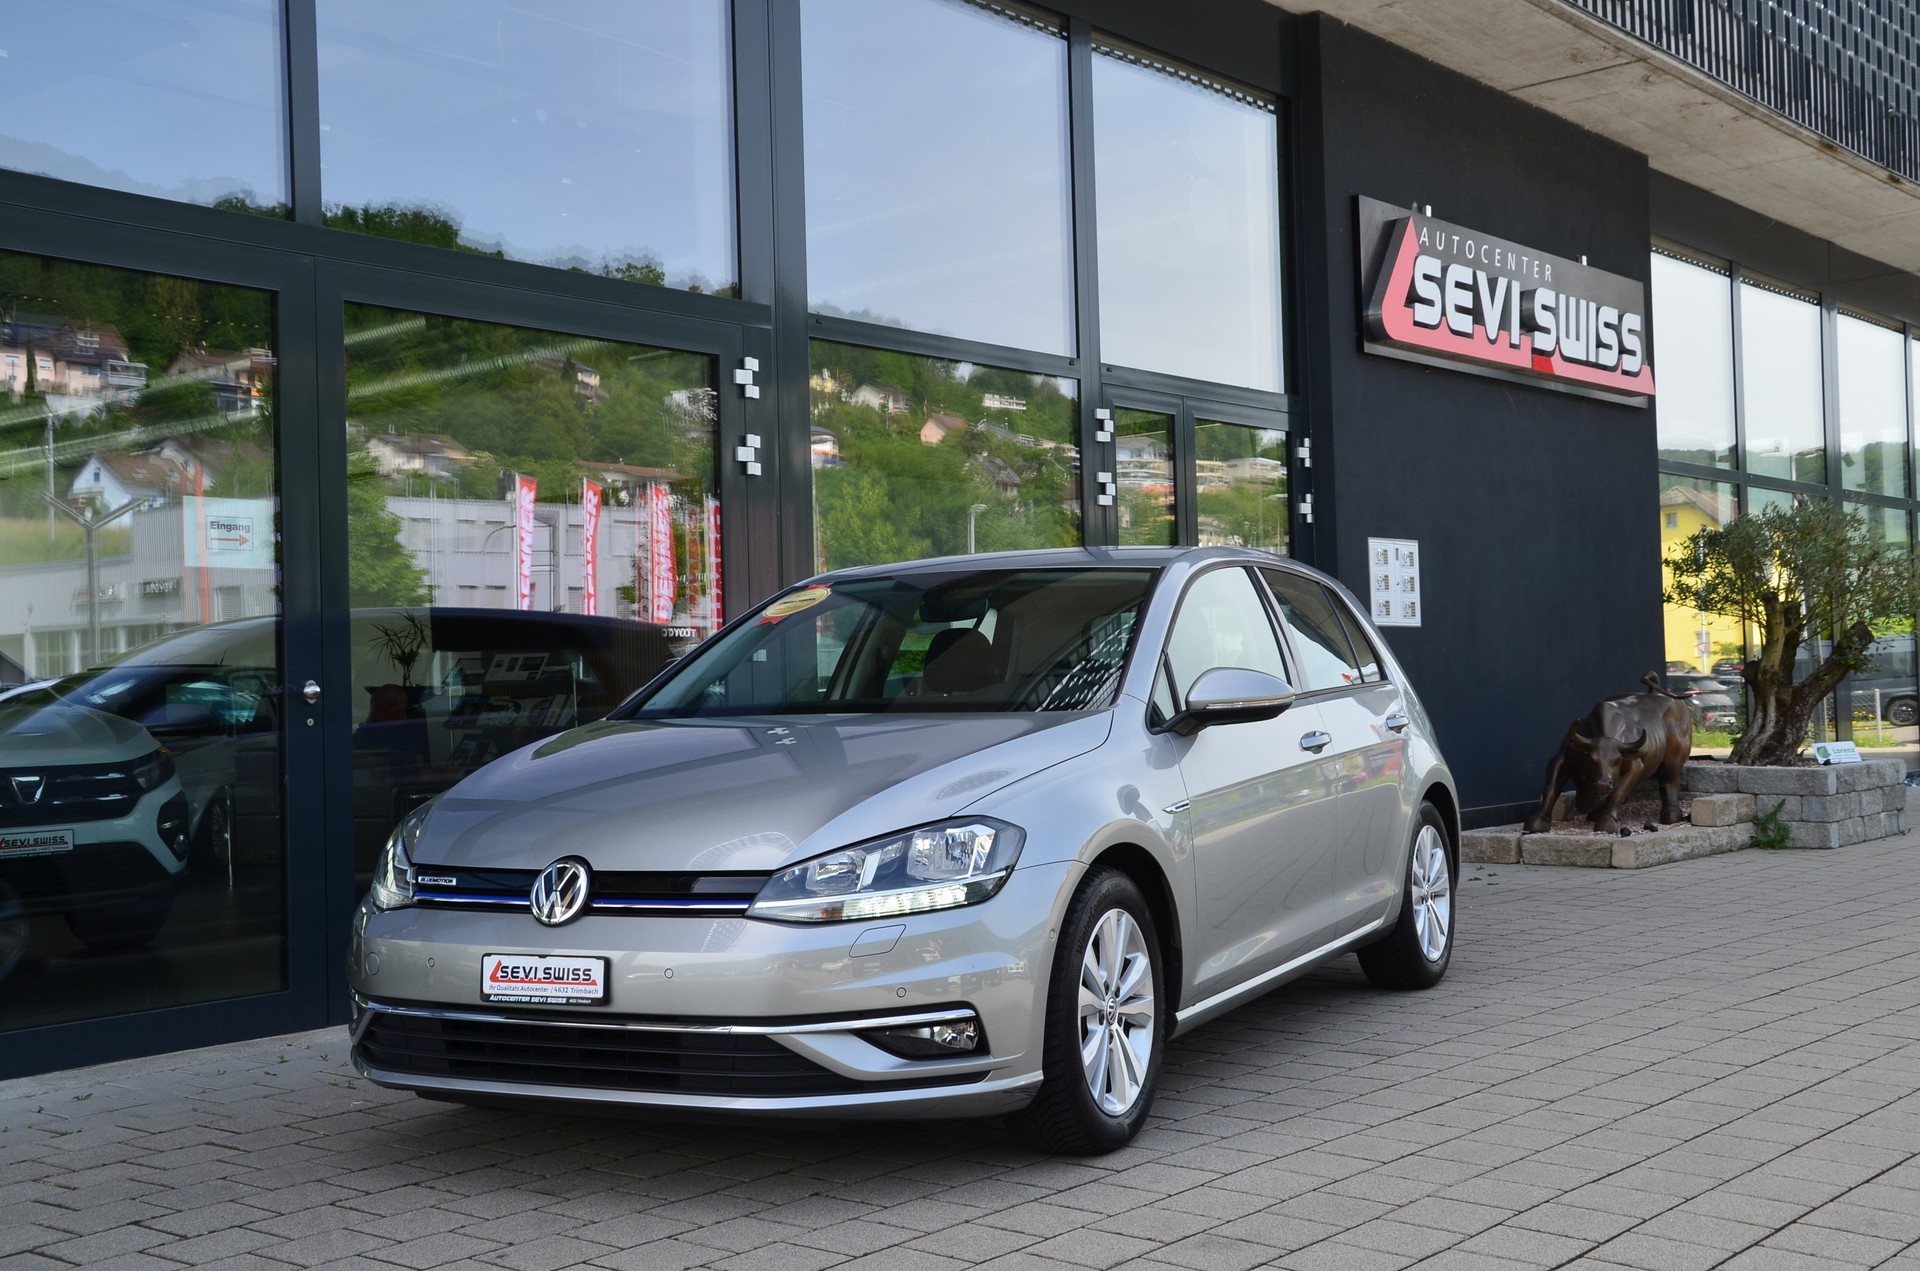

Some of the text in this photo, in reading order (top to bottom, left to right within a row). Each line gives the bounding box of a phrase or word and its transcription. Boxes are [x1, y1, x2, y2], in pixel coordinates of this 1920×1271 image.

[1419, 226, 1552, 282] AUTOCENTER
[1412, 254, 1642, 373] SEVI SWISS
[210, 521, 251, 533] Eingang
[4, 836, 66, 847] SEVI SWISS
[500, 966, 592, 982] SEVI SWISS
